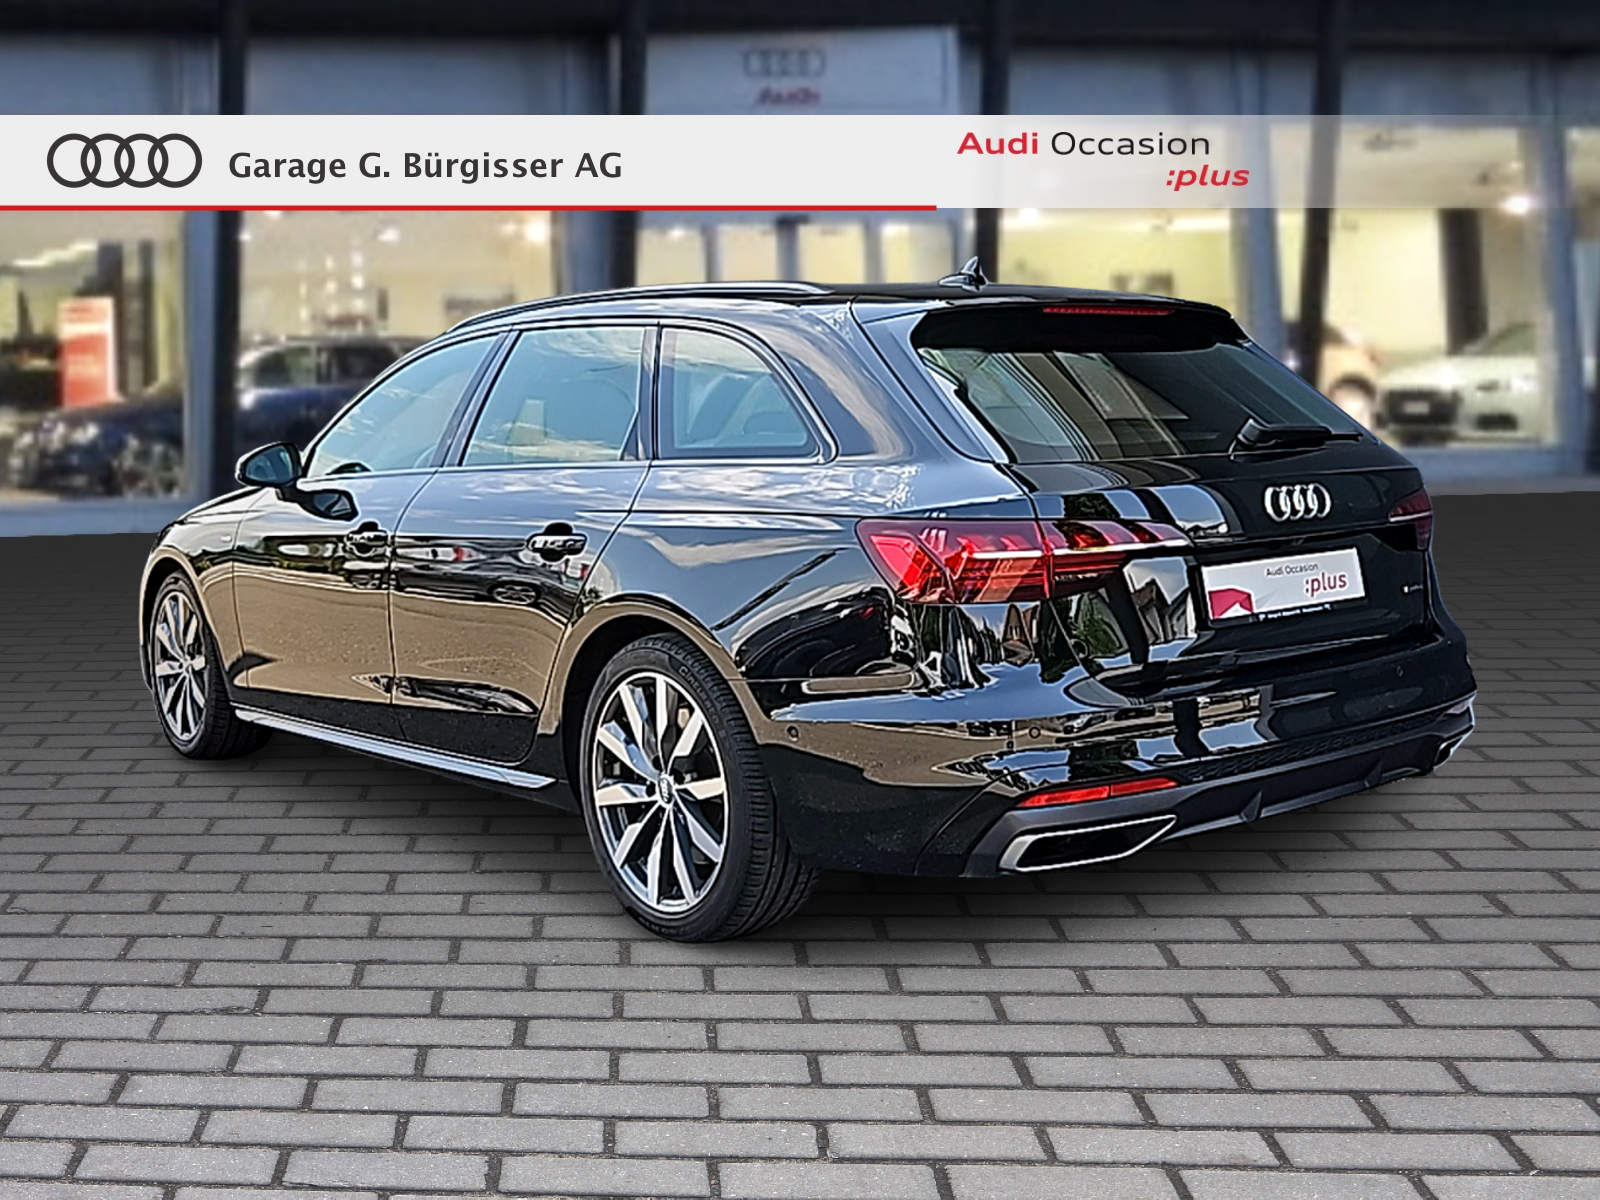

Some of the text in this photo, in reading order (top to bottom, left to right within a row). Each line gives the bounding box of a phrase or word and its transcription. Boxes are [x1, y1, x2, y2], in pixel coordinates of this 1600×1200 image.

[1266, 562, 1319, 577] Audi Occasion
[1305, 572, 1347, 597] :plus
